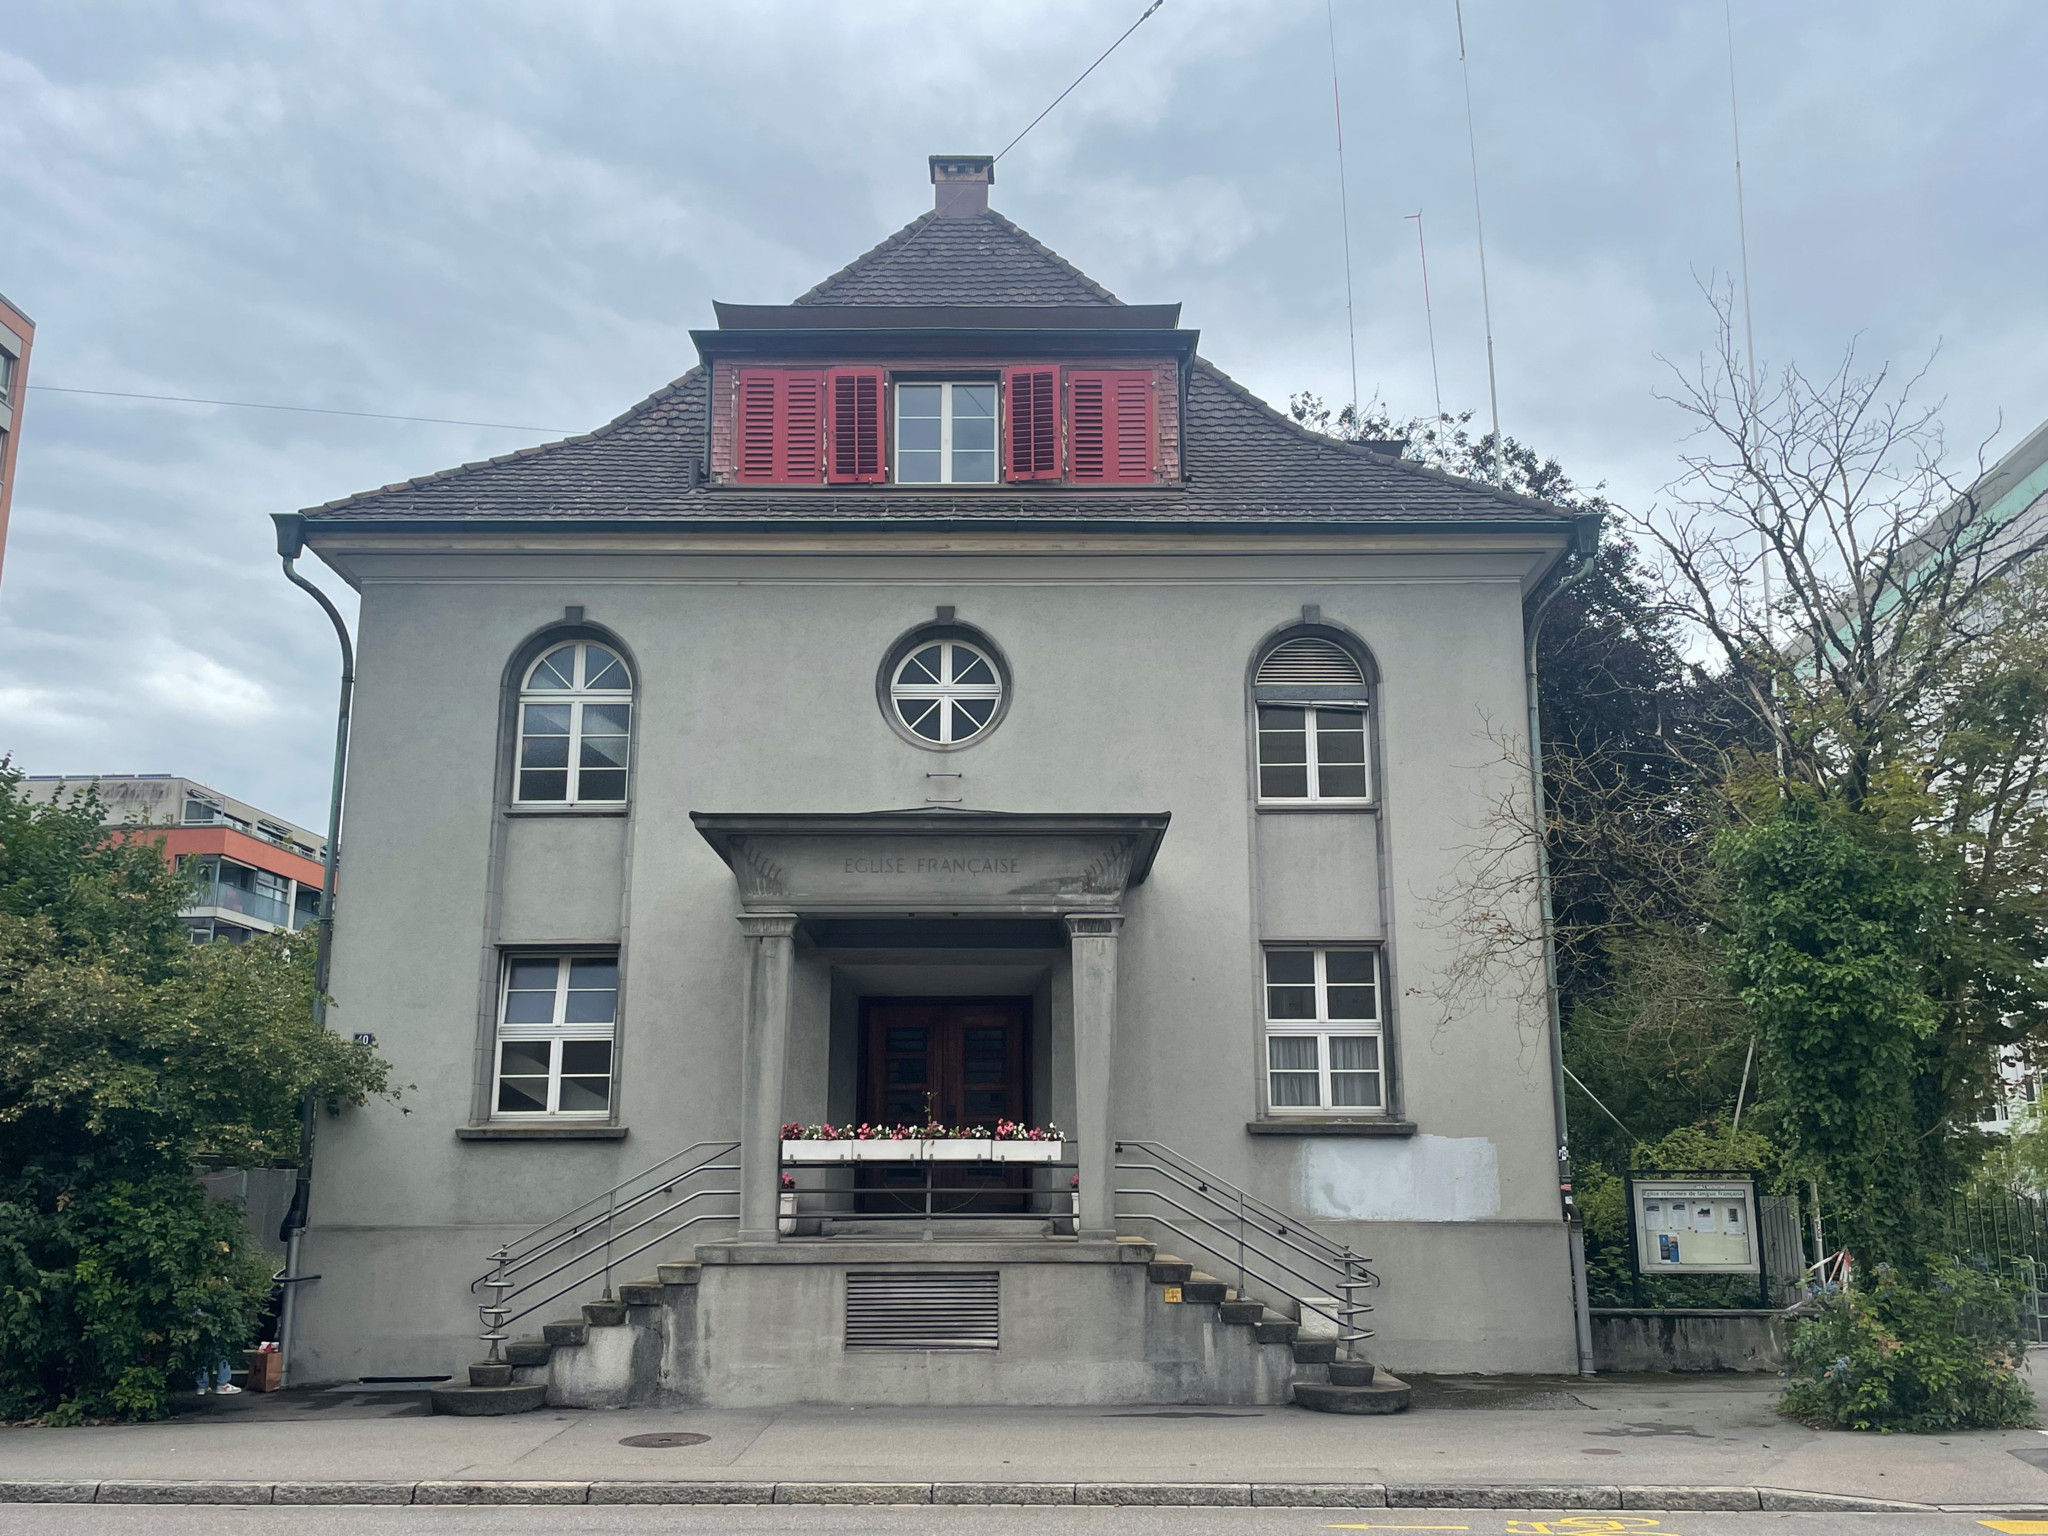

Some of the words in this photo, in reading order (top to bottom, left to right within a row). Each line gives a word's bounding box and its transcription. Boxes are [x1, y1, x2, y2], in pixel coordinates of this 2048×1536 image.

[844, 858, 906, 873] EGLISE
[917, 857, 1021, 877] FRANÇAISE
[357, 1034, 369, 1045] 0
